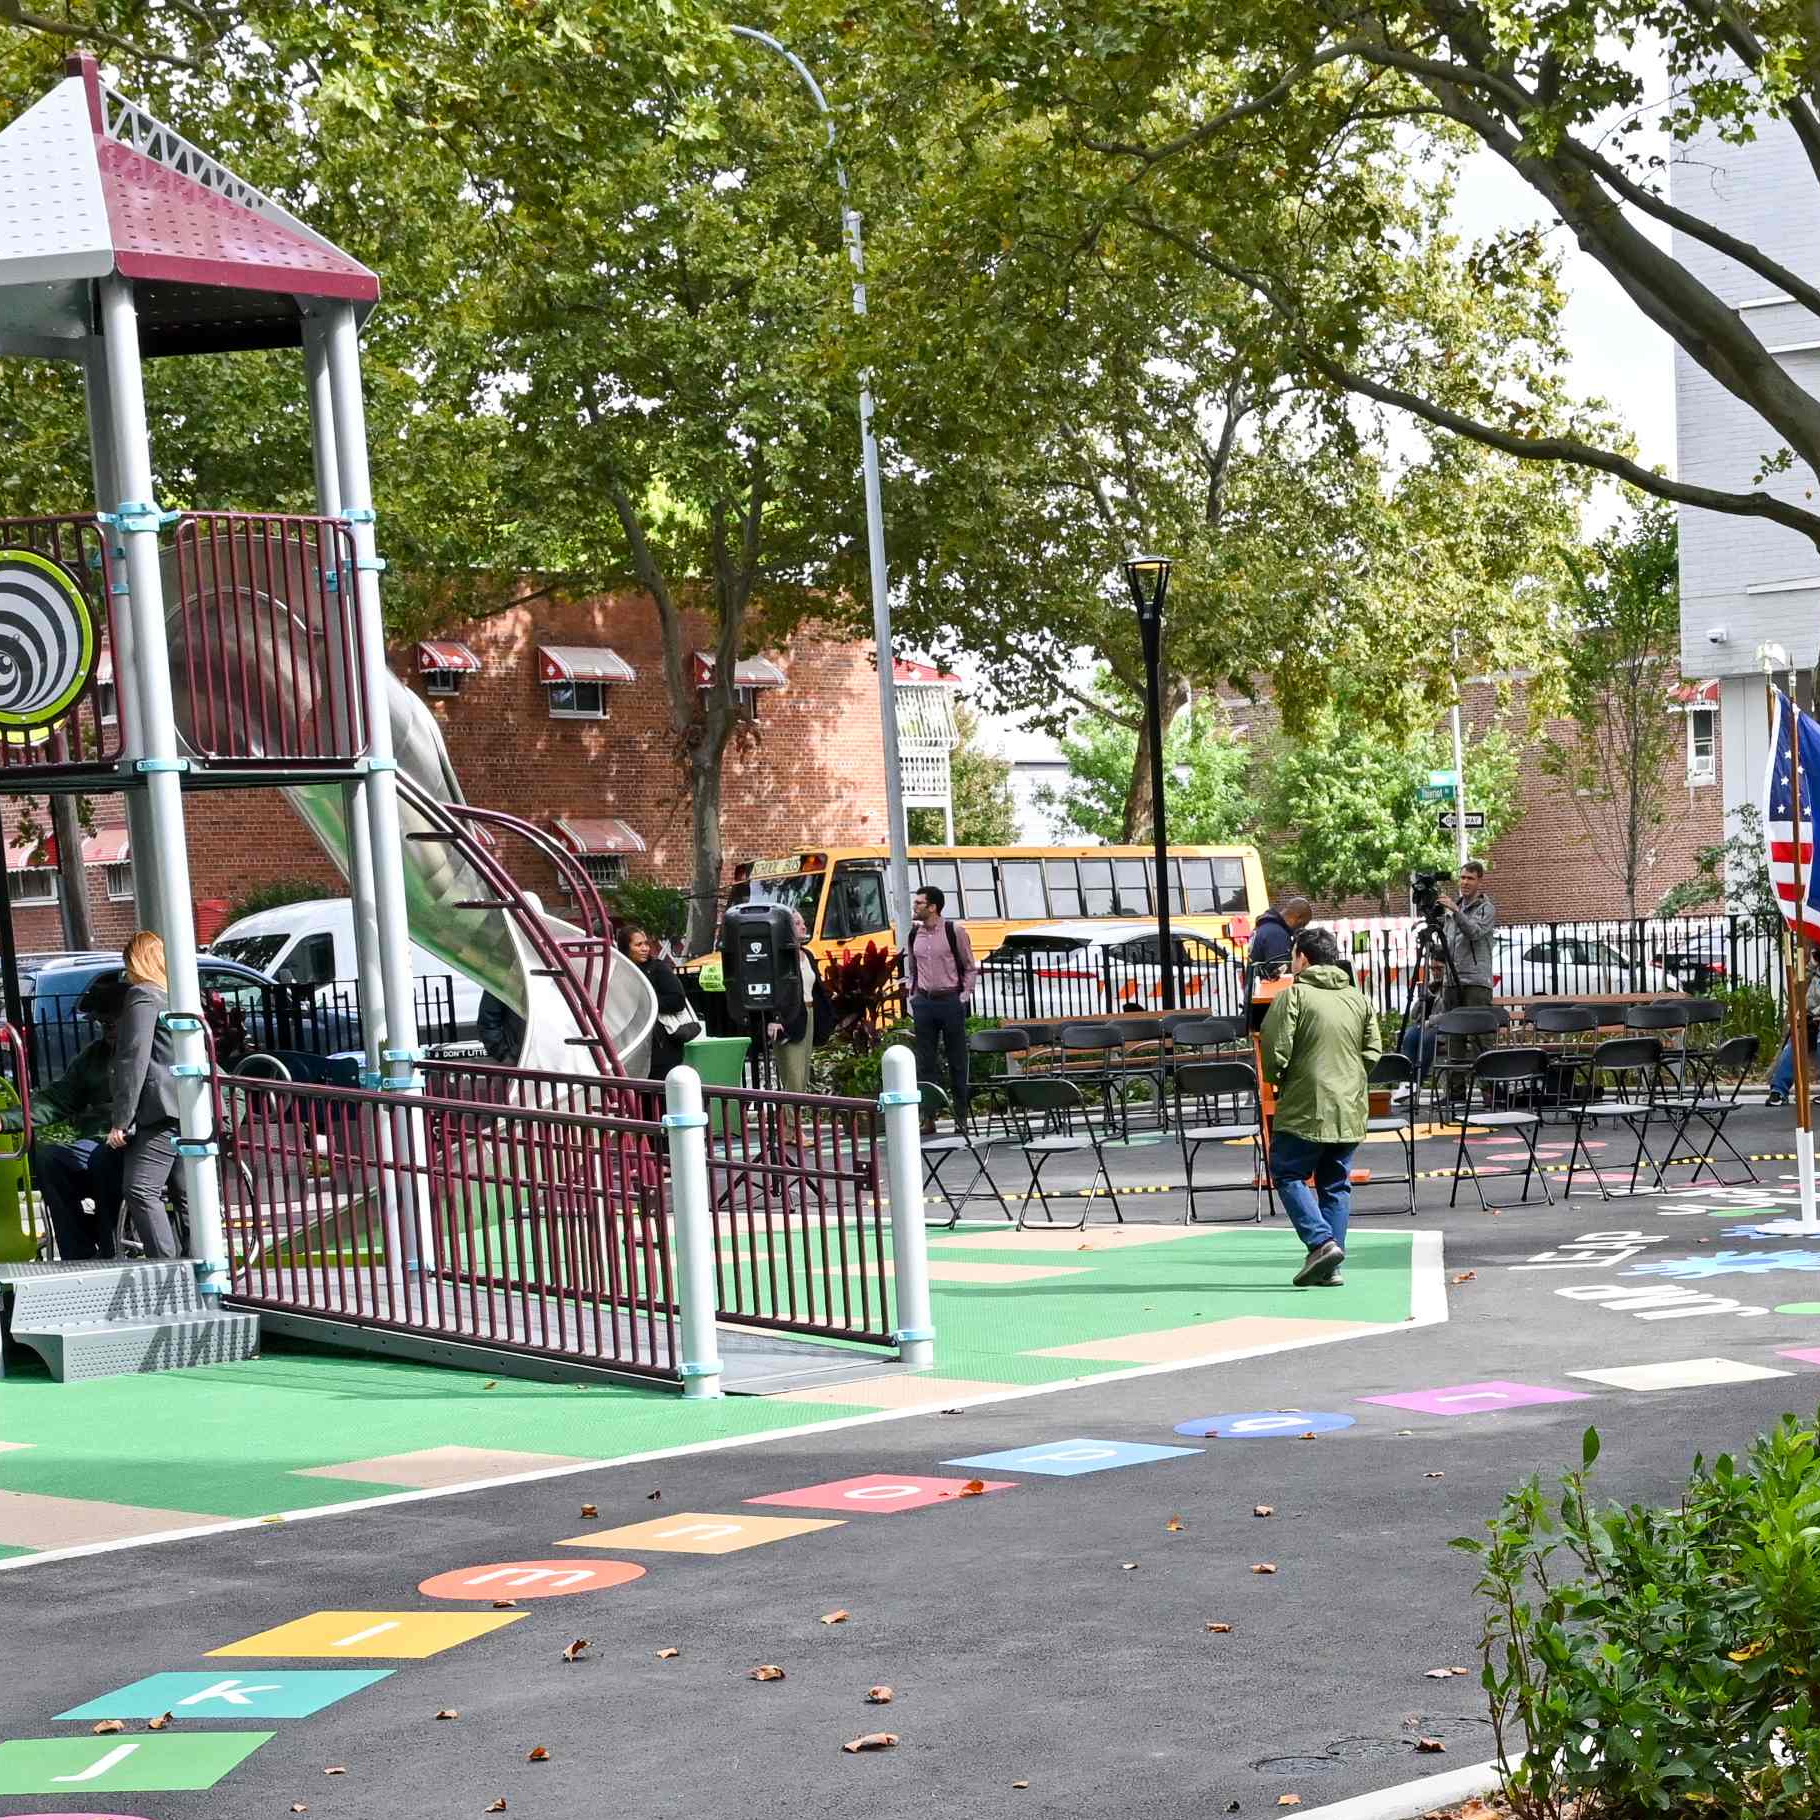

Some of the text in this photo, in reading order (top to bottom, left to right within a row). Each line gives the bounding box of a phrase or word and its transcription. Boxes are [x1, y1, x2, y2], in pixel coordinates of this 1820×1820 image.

[1508, 1230, 1670, 1271] LEAP
[1553, 1284, 1771, 1321] JUMP
[1015, 1448, 1119, 1463] p
[842, 1485, 923, 1499] o
[652, 1524, 742, 1541] n
[462, 1567, 595, 1587] m
[175, 1679, 284, 1705] k
